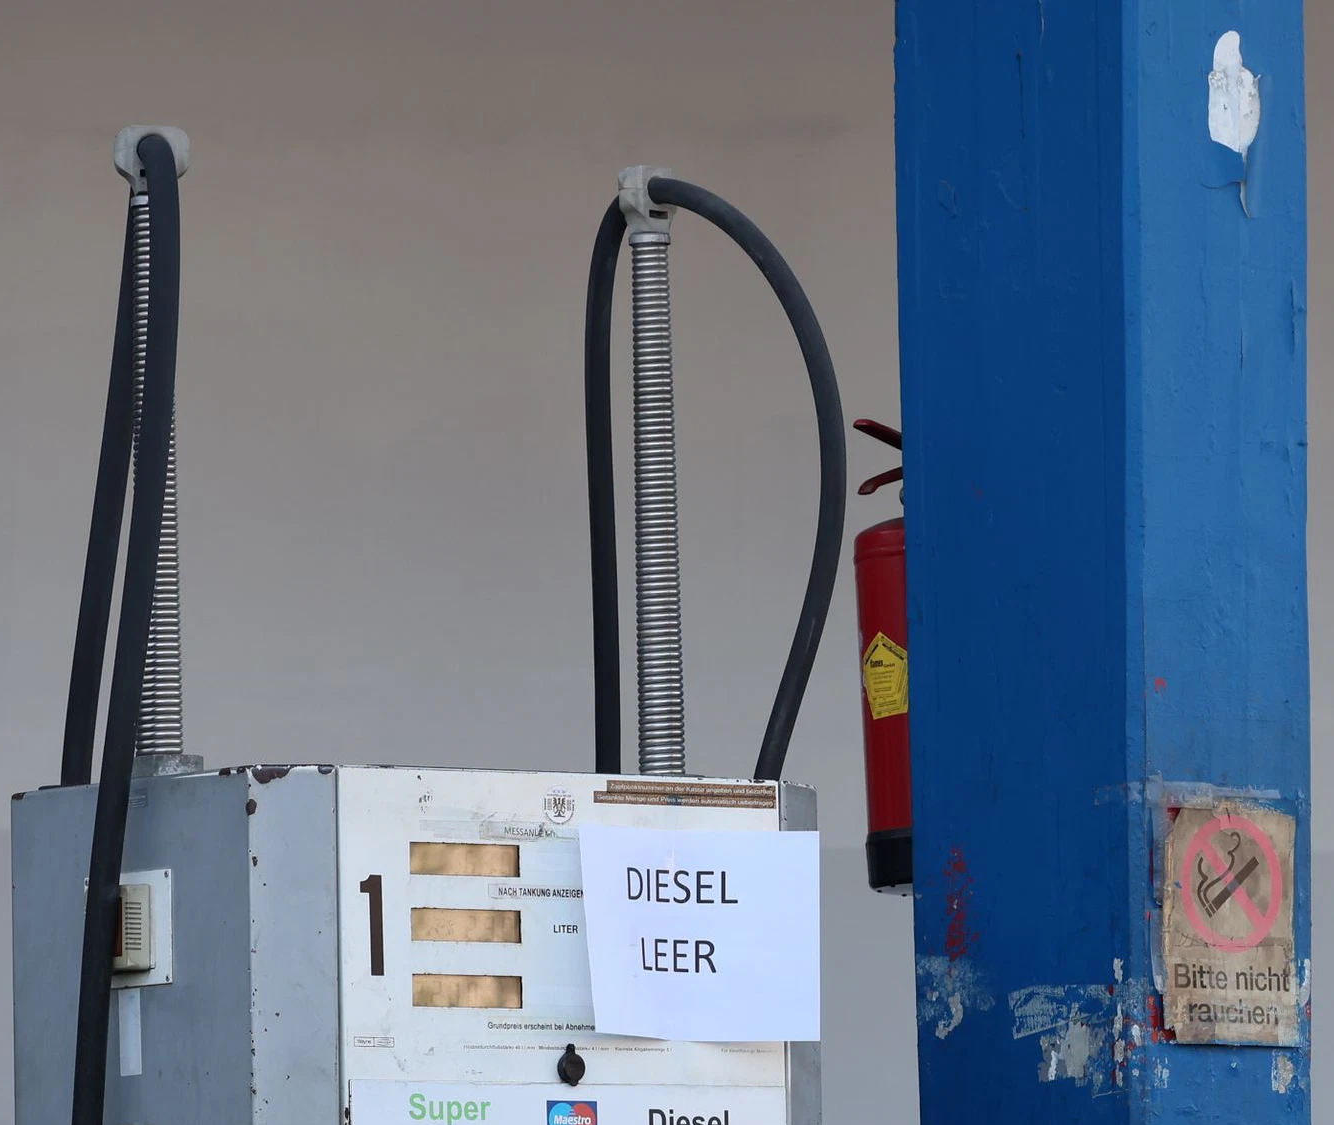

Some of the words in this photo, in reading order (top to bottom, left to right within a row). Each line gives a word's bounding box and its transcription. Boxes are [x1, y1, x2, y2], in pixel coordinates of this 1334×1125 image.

[498, 888, 517, 896] NACH
[519, 888, 550, 898] TANKUNG
[626, 867, 738, 905] DIESEL
[359, 874, 385, 976] 1
[553, 923, 579, 934] LITER
[641, 937, 717, 974] LEER
[1174, 963, 1227, 990] Bitte
[1235, 966, 1290, 992] nicht
[1188, 1001, 1279, 1026] rauchen
[487, 1022, 523, 1032] Grundpreis
[524, 1022, 553, 1031] erscheint
[554, 1022, 564, 1031] bei
[553, 1114, 593, 1125] Maestro
